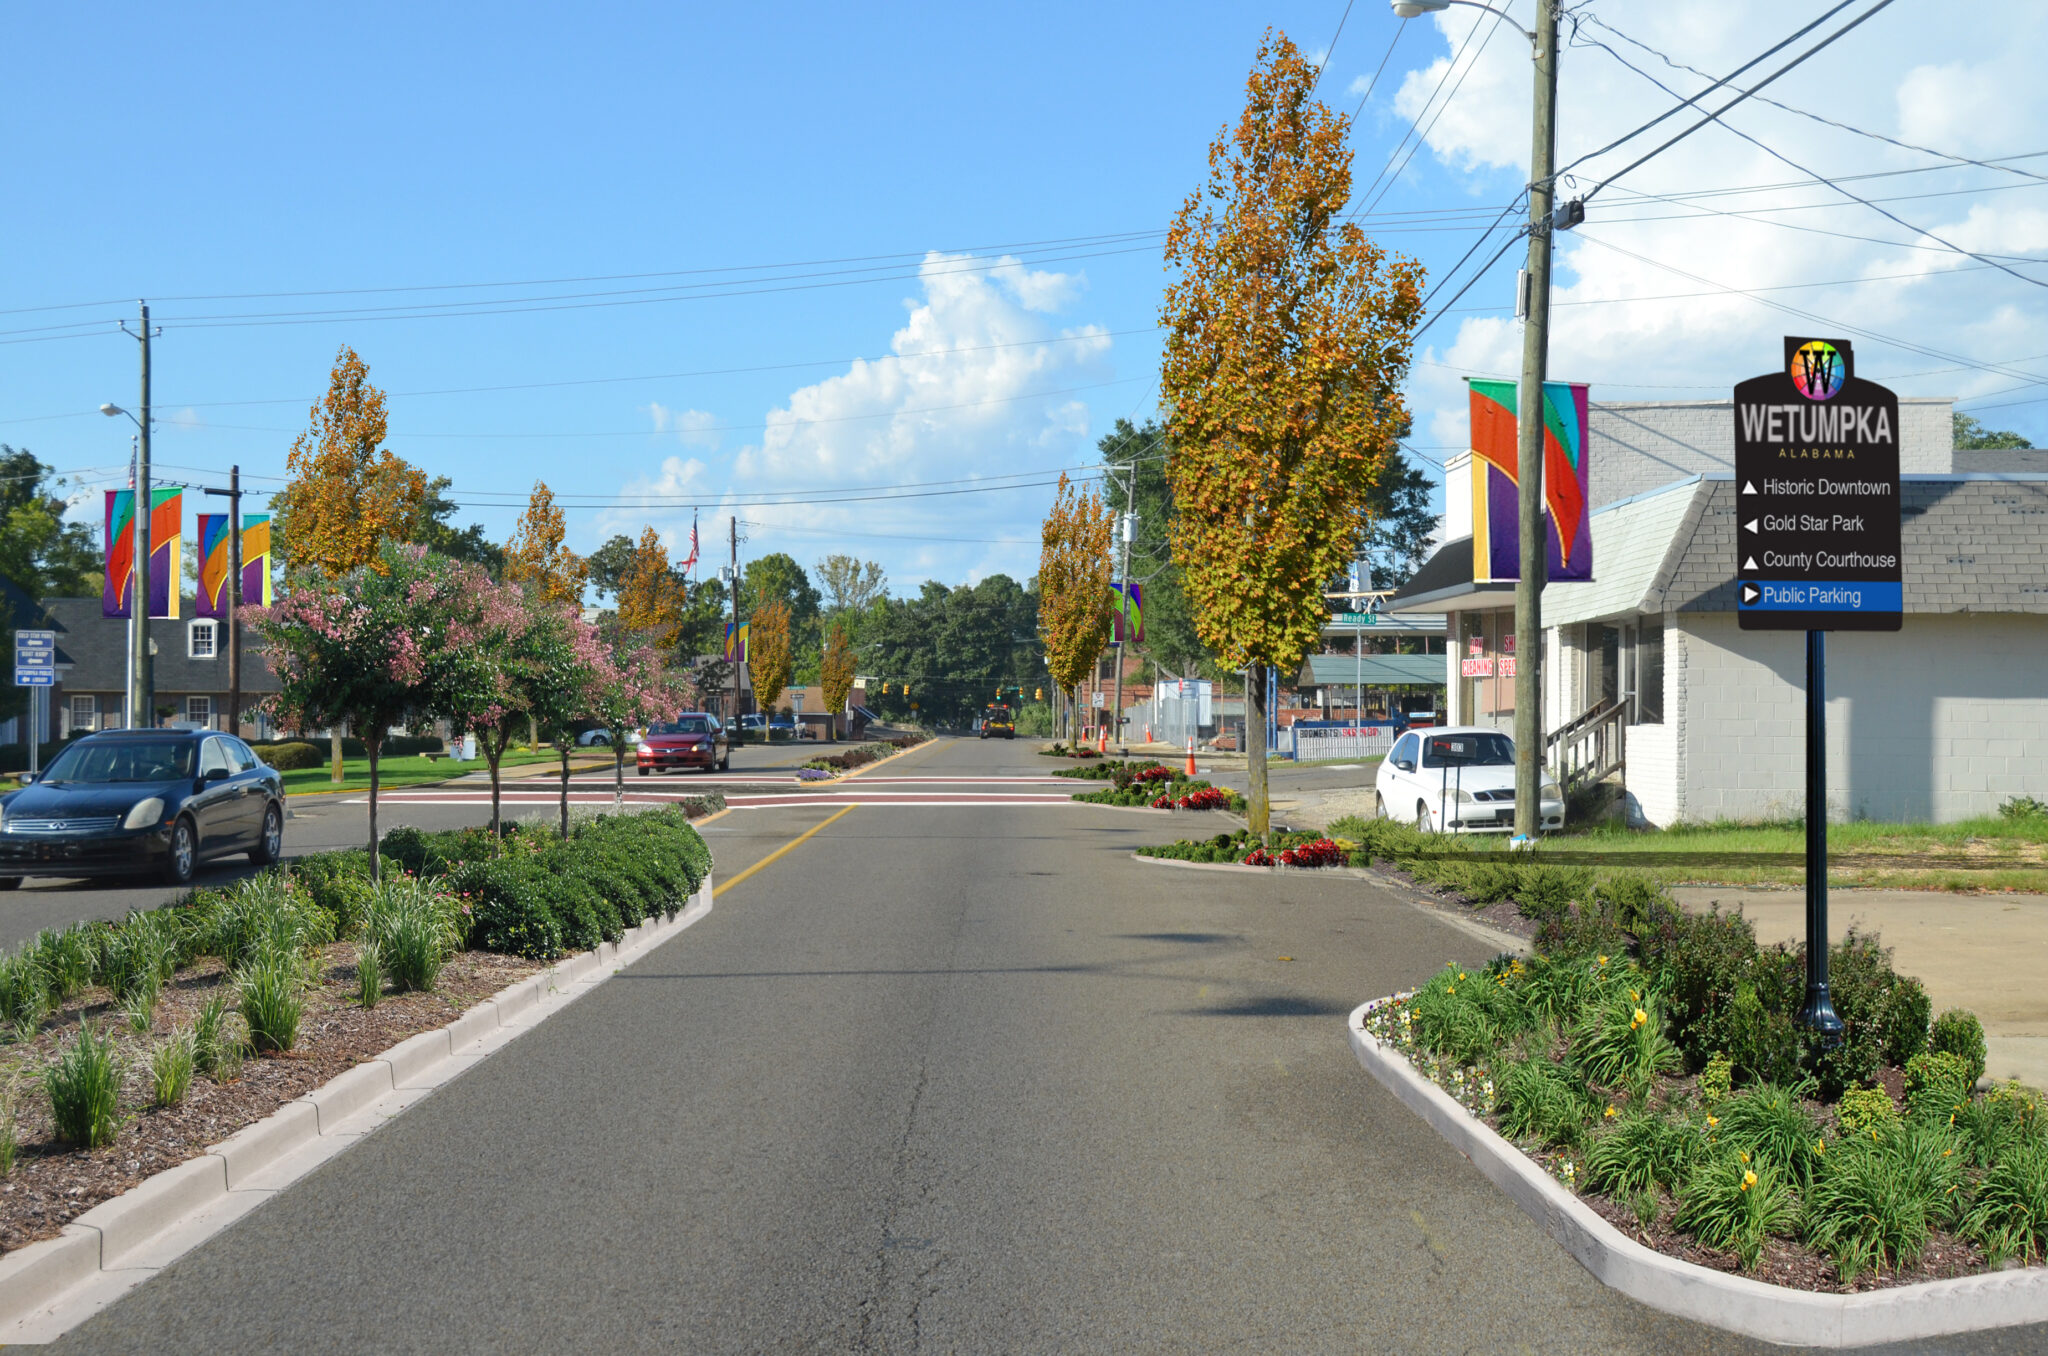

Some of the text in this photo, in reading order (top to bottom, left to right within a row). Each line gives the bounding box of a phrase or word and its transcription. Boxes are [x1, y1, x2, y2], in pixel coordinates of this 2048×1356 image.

[1740, 403, 1892, 444] WETUMPKA
[1779, 448, 1855, 459] ALABAMA
[1763, 478, 1891, 495] Historic Downtown
[1763, 515, 1864, 531] Gold Star Park
[1763, 551, 1896, 571] County Courthouse
[1764, 587, 1861, 607] Public Parking
[1343, 613, 1376, 624] Ready St
[1470, 637, 1483, 654] DRY
[1504, 634, 1516, 652] SHI
[1462, 659, 1493, 677] CLEANING
[1499, 658, 1516, 676] SPEC
